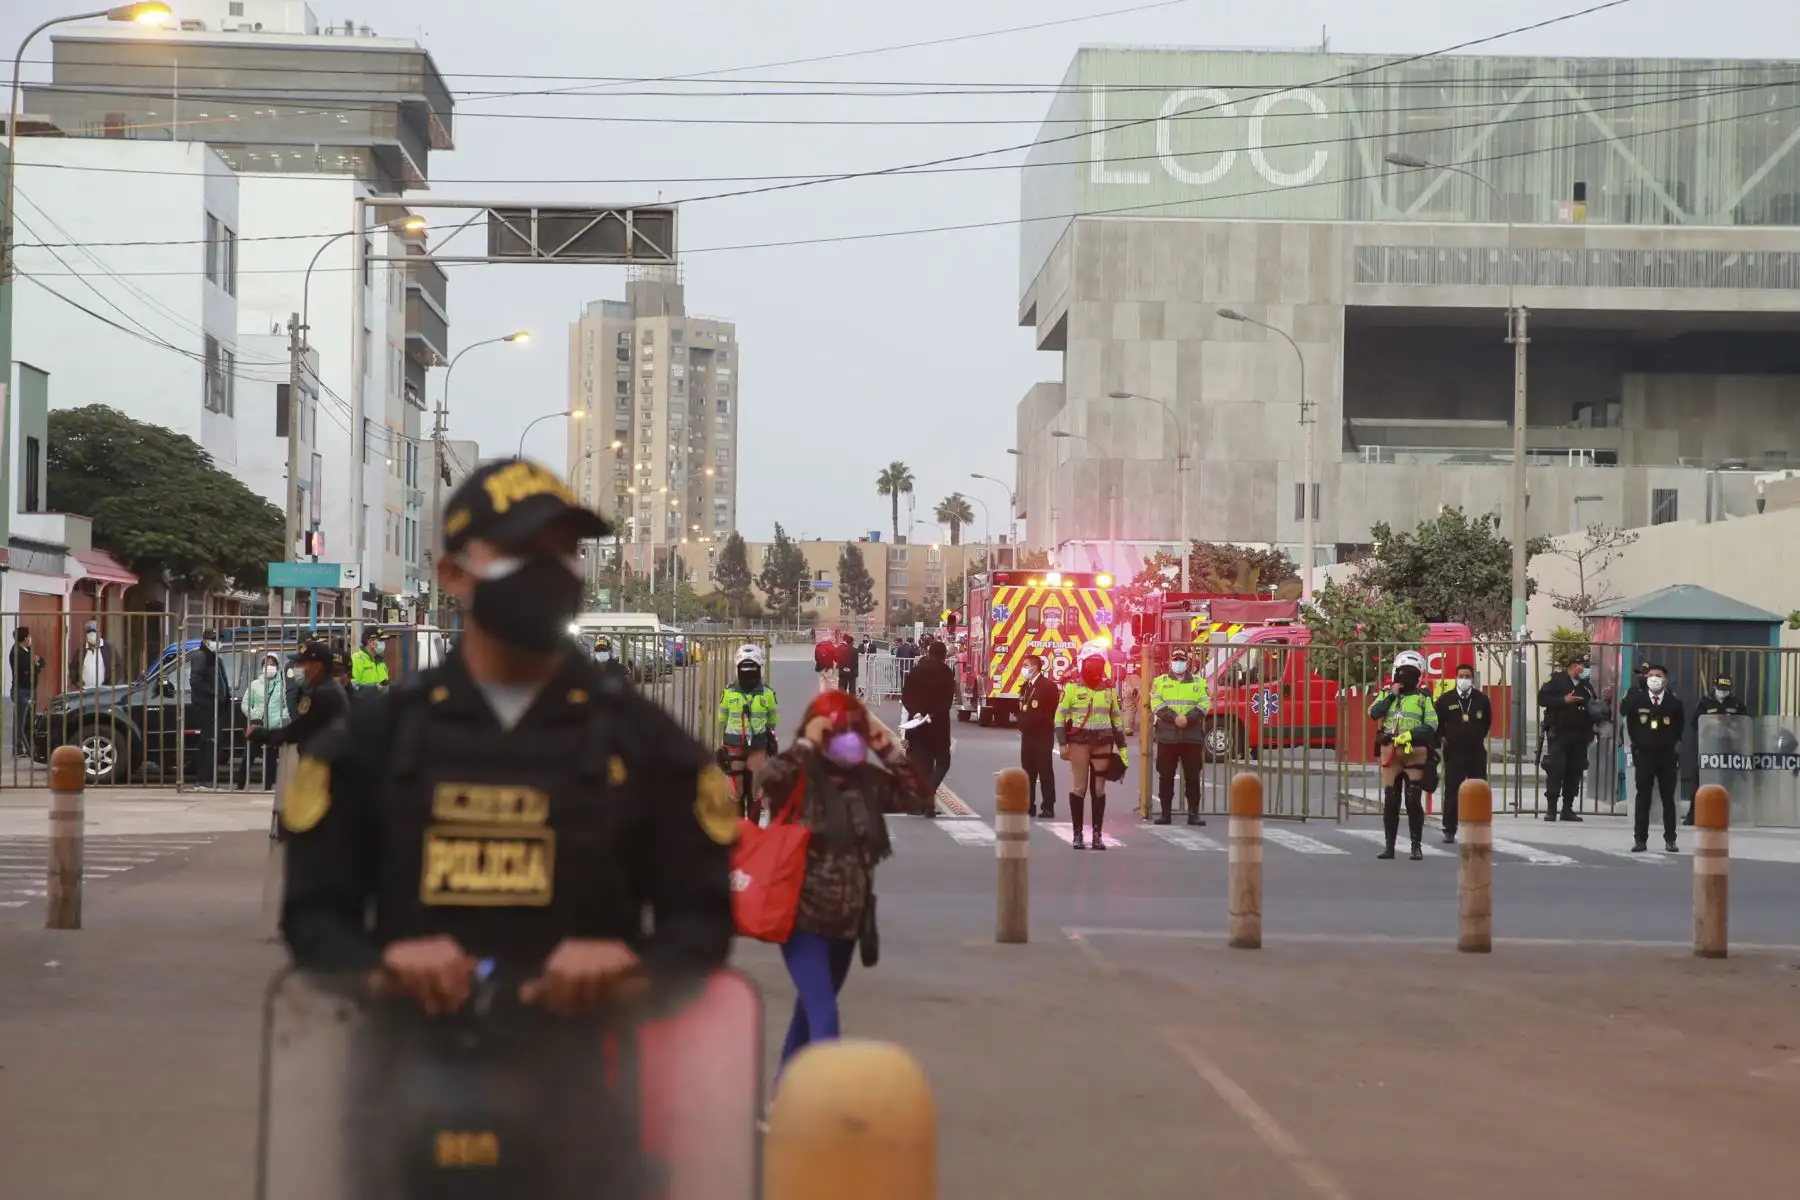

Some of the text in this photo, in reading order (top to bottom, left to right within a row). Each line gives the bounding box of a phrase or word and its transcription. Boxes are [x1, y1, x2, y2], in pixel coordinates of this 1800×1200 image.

[1091, 83, 1327, 186] LCC
[1700, 754, 1752, 770] POLICIA
[1752, 756, 1800, 770] POLICI
